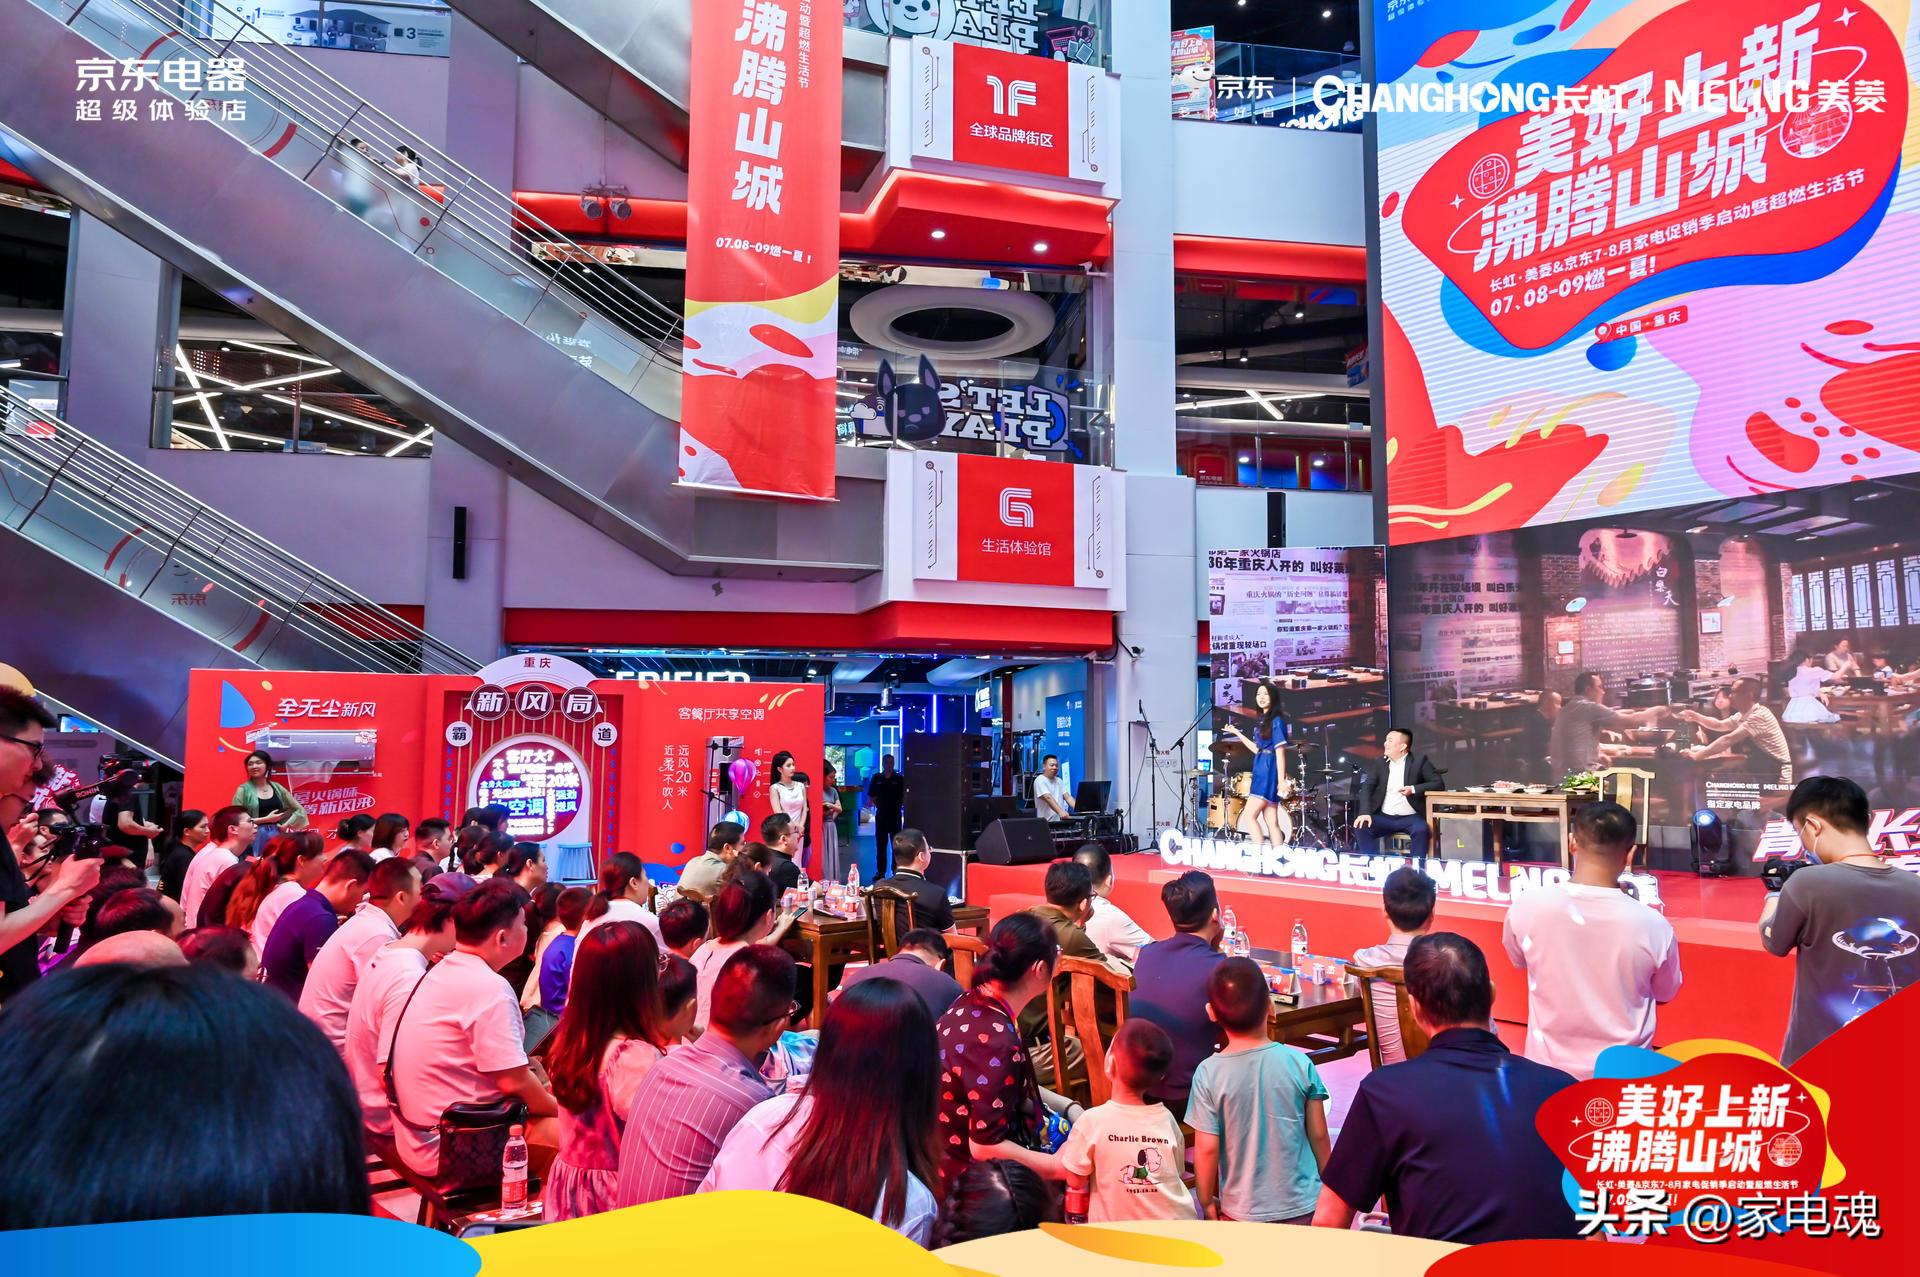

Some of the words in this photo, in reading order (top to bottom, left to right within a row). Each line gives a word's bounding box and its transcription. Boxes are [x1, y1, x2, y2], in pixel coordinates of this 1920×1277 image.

[986, 74, 1037, 117] 1F
[1513, 2, 1822, 190] 美好上新
[731, 0, 788, 215] 沸腾山城
[970, 122, 1054, 148] 全球品牌街区
[1473, 108, 1769, 272] 沸腾山城
[981, 538, 1052, 556] 生活体验馆
[523, 657, 552, 668] 重庆
[275, 697, 377, 717] 全无尘新风
[476, 691, 595, 715] 新风局
[678, 707, 765, 722] 客餐厅共享空调
[452, 726, 467, 741] 霸
[598, 727, 612, 741] 道
[75, 786, 100, 798] RONIN
[1108, 1134, 1140, 1143] Charlie
[1141, 1135, 1169, 1144] Brown
